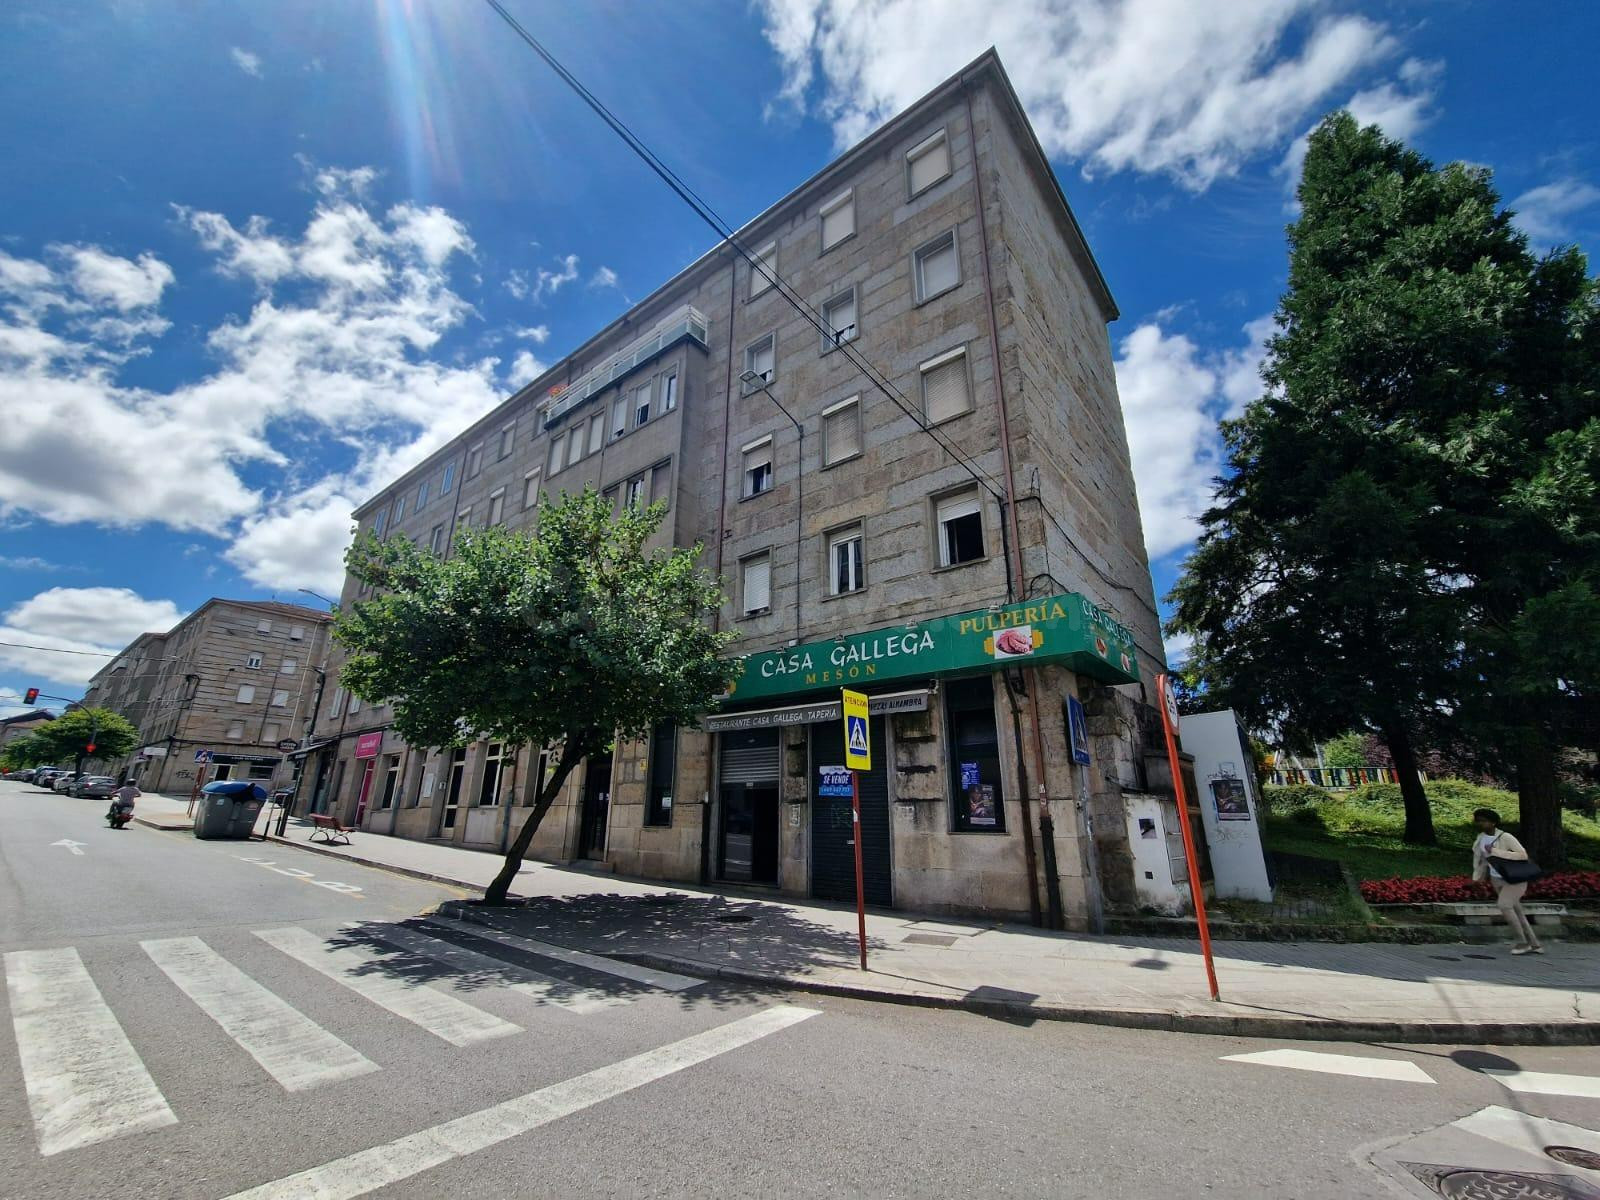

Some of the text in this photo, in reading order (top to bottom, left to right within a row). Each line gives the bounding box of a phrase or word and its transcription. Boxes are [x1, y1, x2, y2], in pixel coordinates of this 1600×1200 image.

[959, 600, 1067, 636] PULPERÍA
[1082, 600, 1103, 624] CASA
[761, 630, 935, 678] CASA GALLEGA
[805, 663, 877, 685] MESÓN
[888, 697, 923, 710] ALHAMBRA
[752, 716, 770, 727] CASA
[773, 712, 803, 724] GALLEGA
[823, 775, 850, 785] SE VENDE
